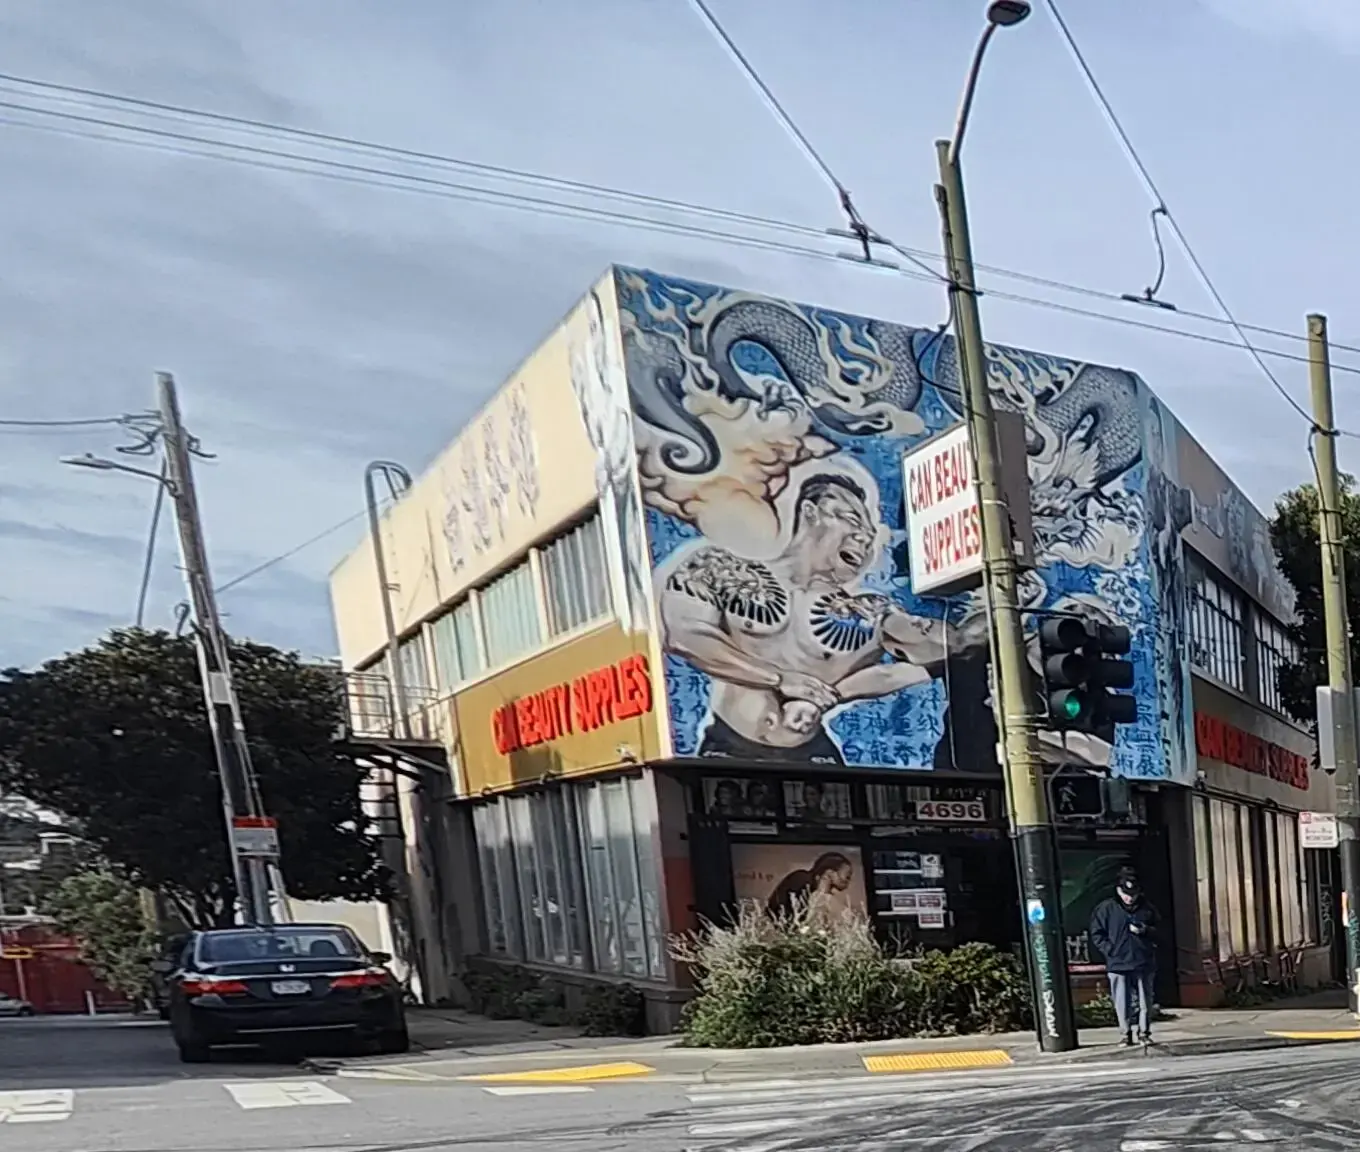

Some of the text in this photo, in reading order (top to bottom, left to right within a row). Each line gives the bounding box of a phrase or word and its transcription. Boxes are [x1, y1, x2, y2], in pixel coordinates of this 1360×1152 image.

[909, 440, 970, 514] CAN BEAU
[922, 504, 981, 575] SUPPLIES
[491, 699, 520, 755] CAN
[516, 681, 573, 747] BEAUTY
[572, 652, 653, 732] SUPPLIES
[919, 802, 982, 819] 4696
